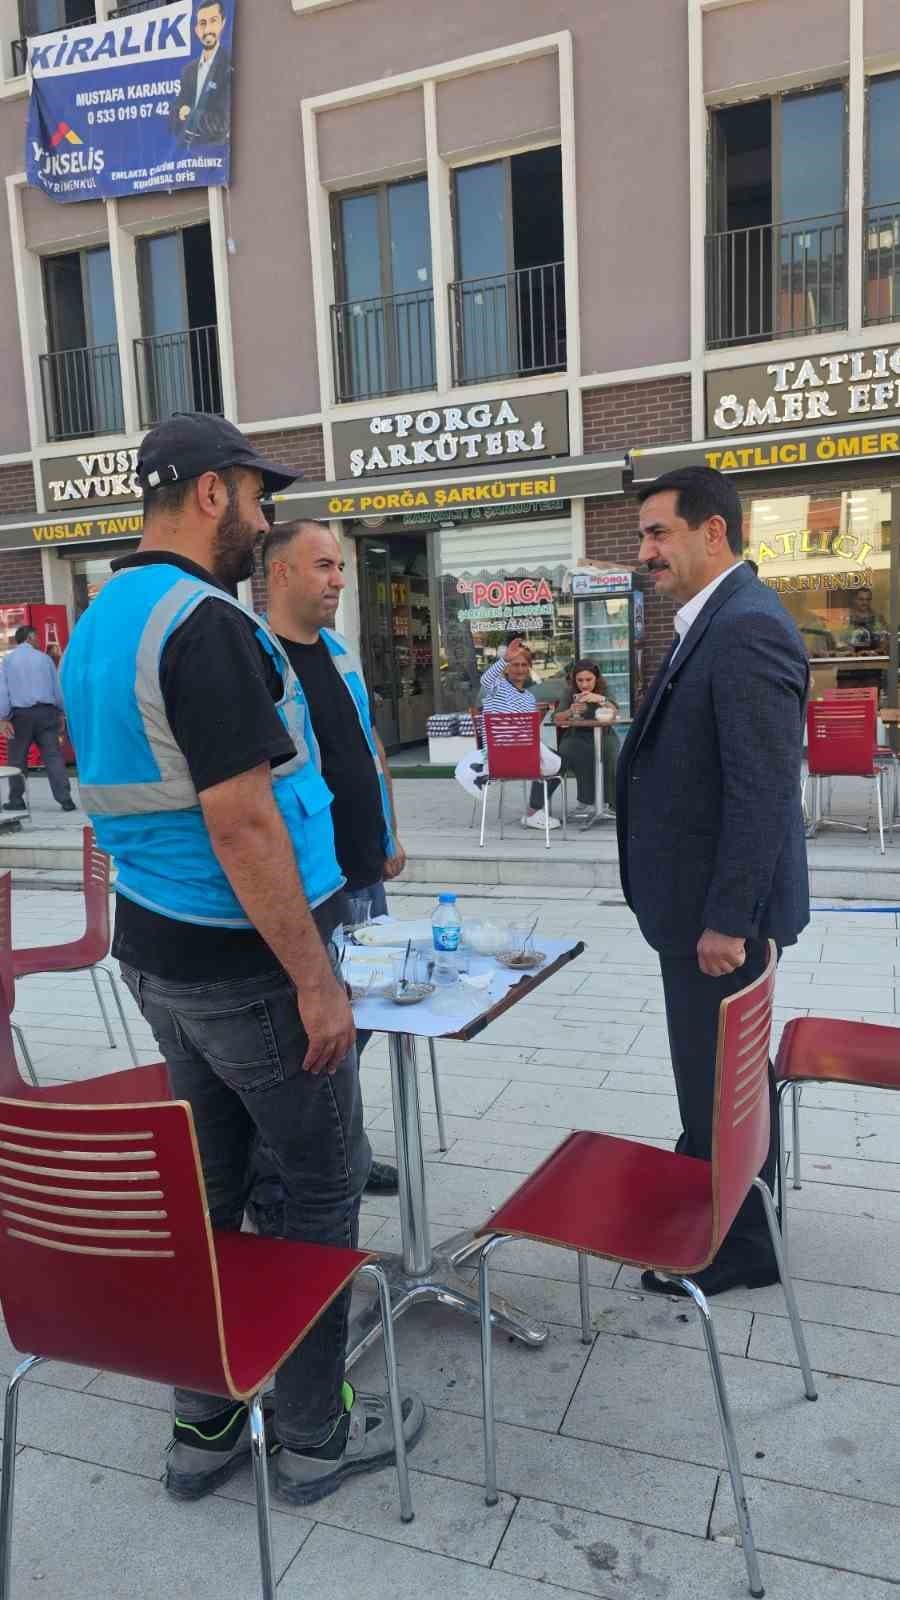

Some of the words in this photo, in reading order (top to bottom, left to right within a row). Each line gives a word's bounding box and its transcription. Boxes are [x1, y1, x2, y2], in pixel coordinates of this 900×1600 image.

[31, 13, 187, 70] KİRALIK
[76, 89, 125, 107] MUSTAFA
[127, 79, 182, 99] KARAKUŞ
[87, 112, 95, 125] 0
[96, 111, 116, 124] 533
[118, 108, 138, 121] 019
[140, 105, 153, 118] 67
[156, 102, 170, 116] 42
[111, 168, 148, 181] EMLAKTA
[175, 170, 196, 183] OFİS
[394, 399, 520, 438] PORGA
[713, 390, 838, 430] ÖMER
[349, 420, 546, 477] ŞARKÜTERİ
[705, 443, 807, 470] TATLICI
[816, 432, 899, 460] ÖMER
[328, 496, 354, 514] ÖZ
[360, 488, 429, 511] PORĞA
[434, 476, 557, 507] ŞARKÜTERİ
[32, 522, 93, 541] VUSLAT
[97, 516, 143, 535] TAVU
[742, 529, 873, 566] ATLICI
[472, 577, 553, 608] PORGA
